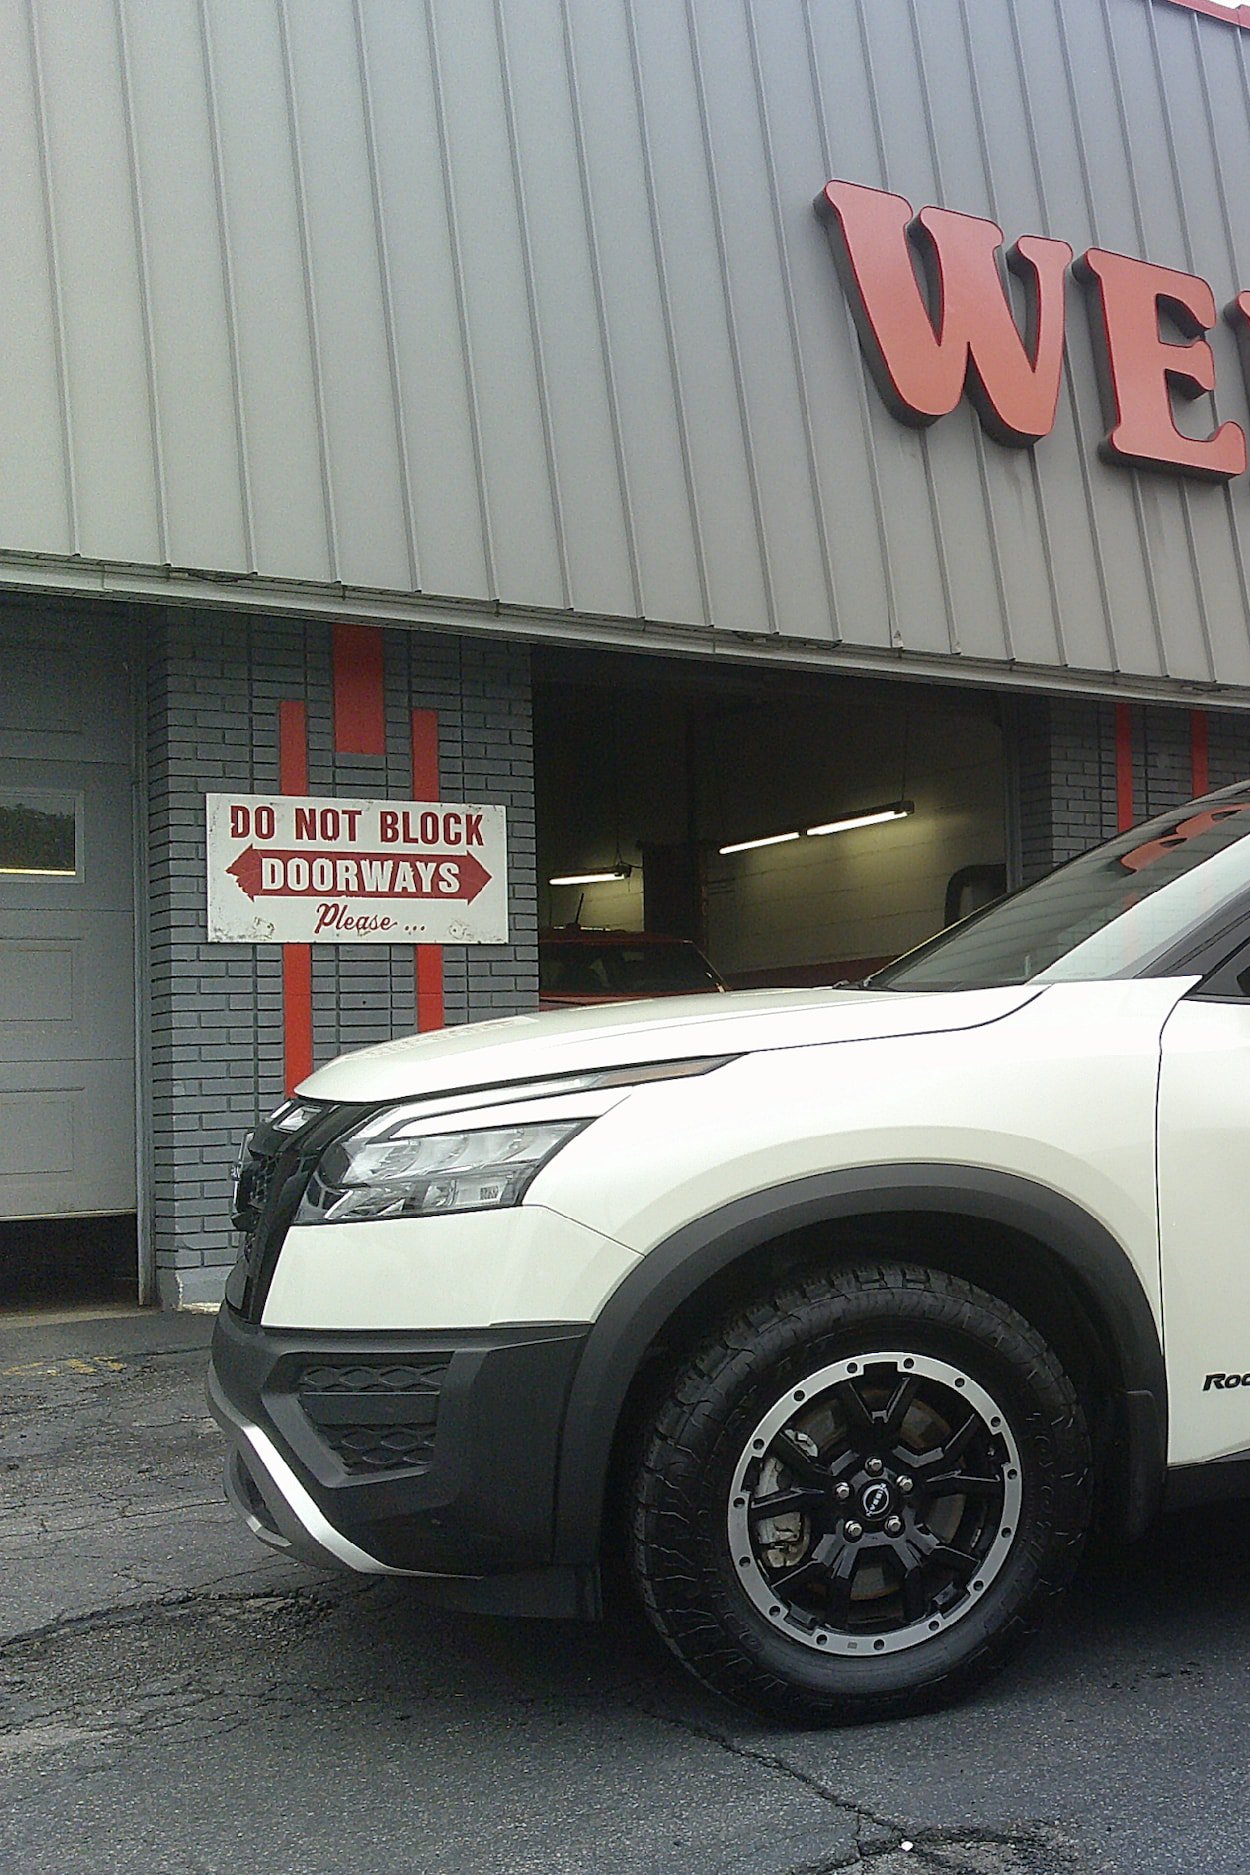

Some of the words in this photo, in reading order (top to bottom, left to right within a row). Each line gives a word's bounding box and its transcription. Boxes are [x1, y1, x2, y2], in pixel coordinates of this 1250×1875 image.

[231, 805, 276, 839] DO
[295, 808, 363, 842] NOT
[380, 811, 484, 846] BLOCK
[262, 857, 461, 893] DOORWAYS
[314, 903, 398, 935] Please
